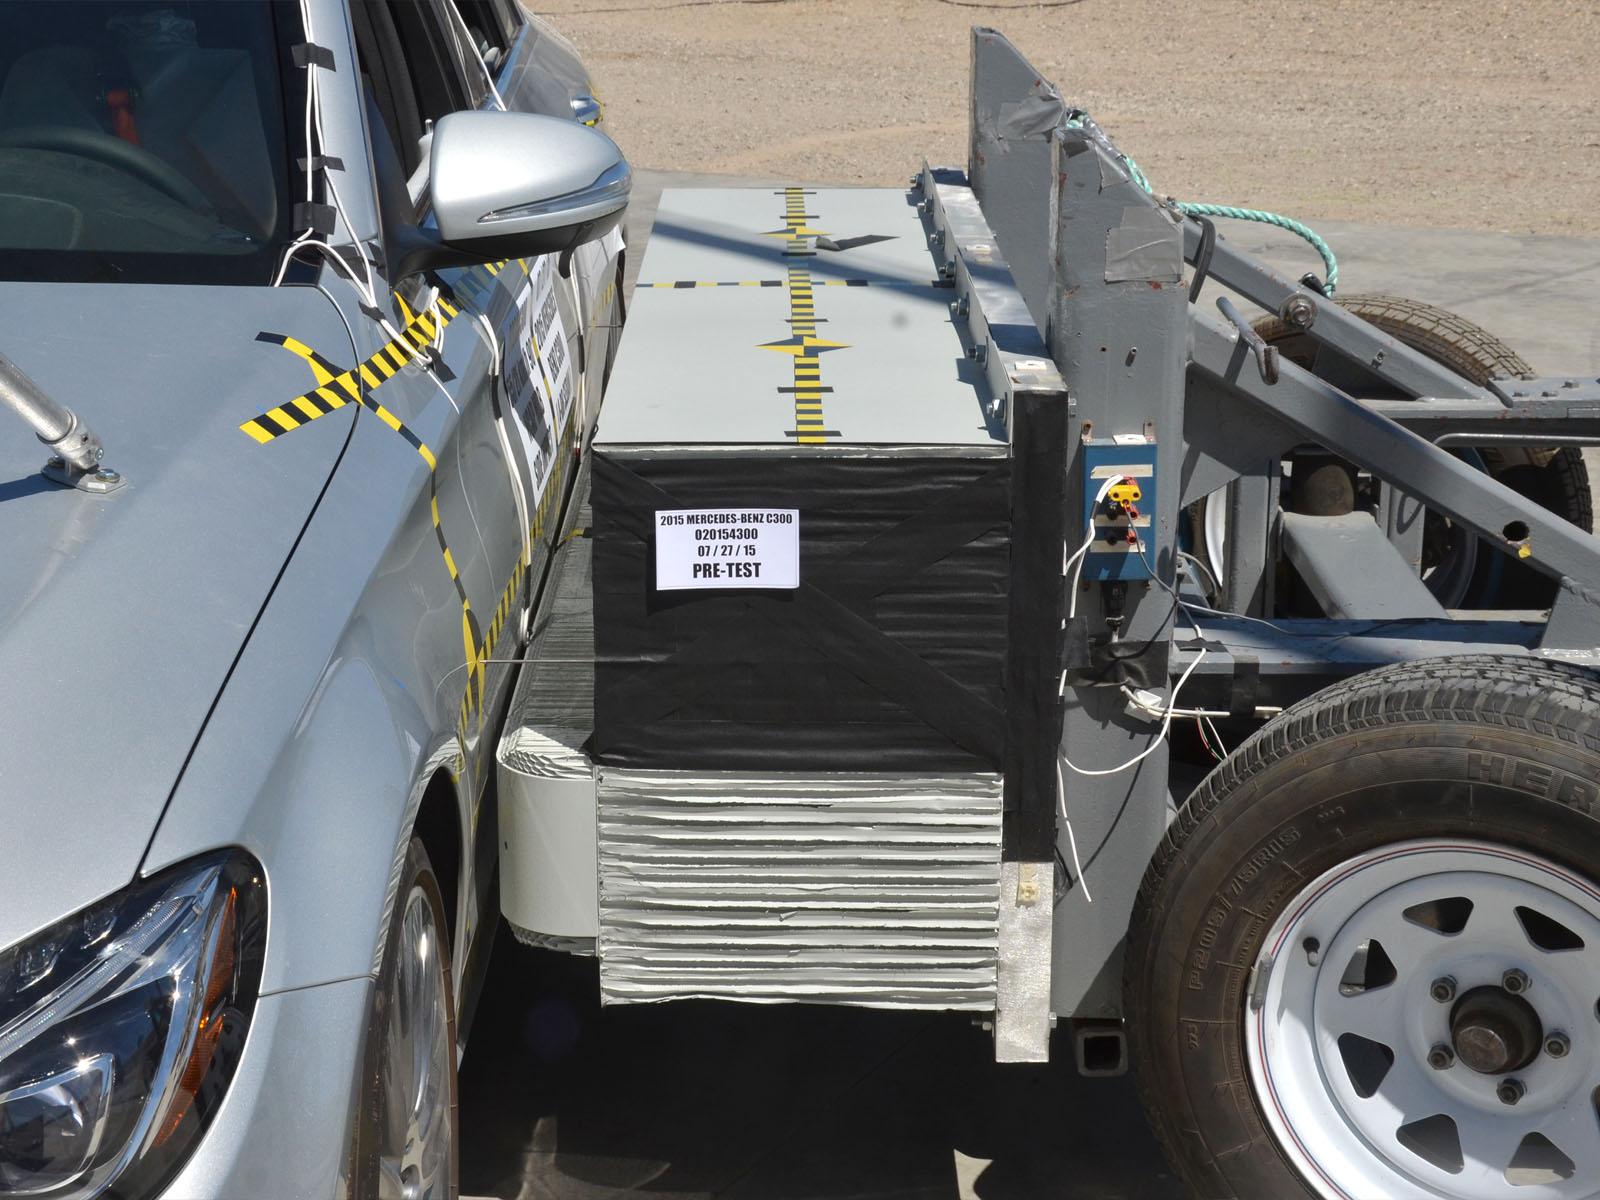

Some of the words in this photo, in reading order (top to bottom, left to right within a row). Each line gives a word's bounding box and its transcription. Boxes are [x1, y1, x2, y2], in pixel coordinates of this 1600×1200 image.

[660, 515, 684, 526] 2015
[686, 513, 764, 525] MERCEDES-BENZ
[766, 513, 793, 524] C300
[695, 528, 758, 540] 020154300
[698, 545, 711, 557] 07
[721, 545, 733, 556] 27
[744, 545, 756, 556] 15
[693, 562, 761, 578] PRE-TEST
